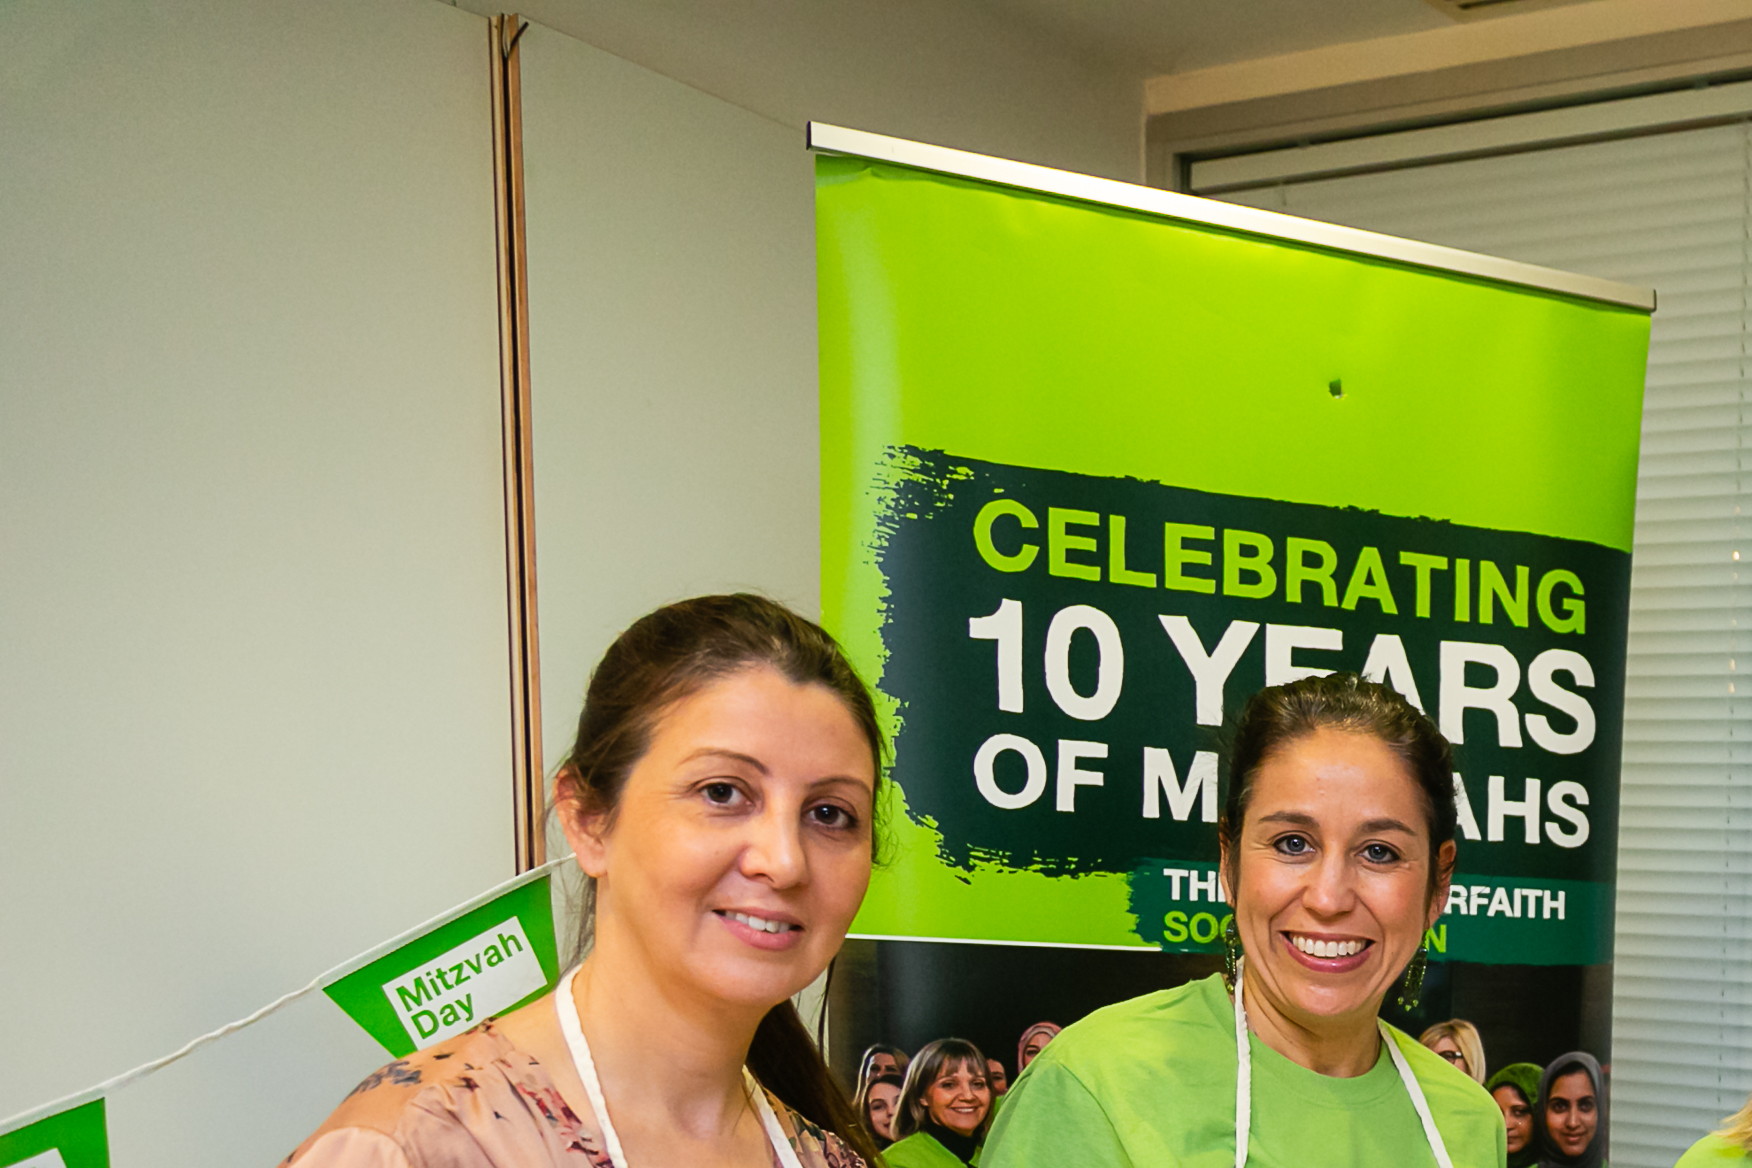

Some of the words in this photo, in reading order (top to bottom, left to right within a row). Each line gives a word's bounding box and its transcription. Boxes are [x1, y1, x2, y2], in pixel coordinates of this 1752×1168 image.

[973, 498, 1587, 635] CELEBRATING
[968, 597, 1125, 722] 10
[973, 733, 1109, 812] OF
[396, 933, 524, 1013] Mitzvah
[410, 992, 474, 1040] Day
